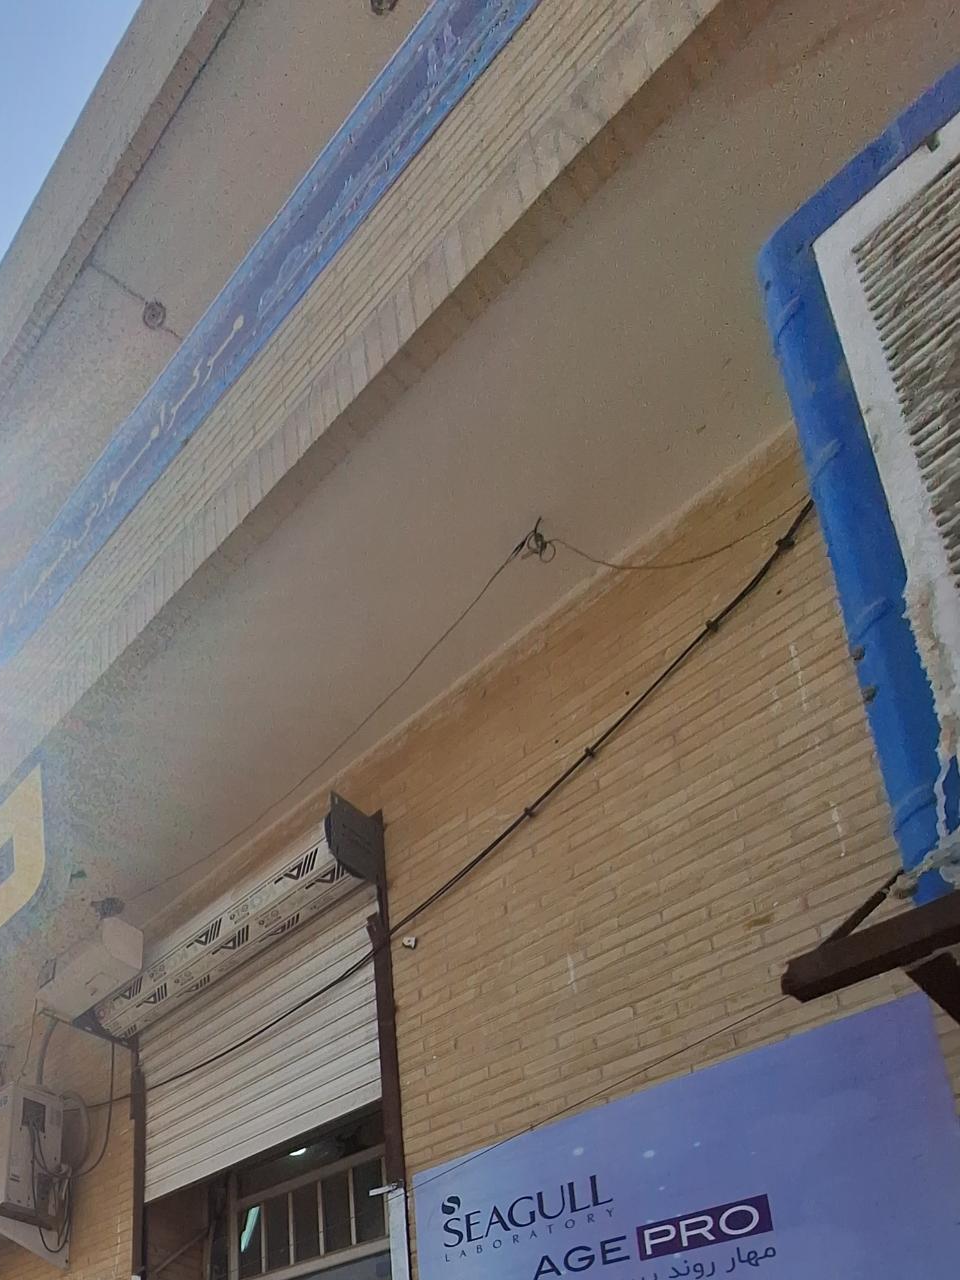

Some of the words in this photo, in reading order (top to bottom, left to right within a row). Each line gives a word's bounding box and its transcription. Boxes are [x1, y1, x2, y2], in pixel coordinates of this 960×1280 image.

[442, 1174, 614, 1248] SEAGULL
[444, 1207, 615, 1262] LABORATORY
[643, 1203, 761, 1256] PRO
[668, 1260, 717, 1280] روند
[726, 1245, 777, 1273] مهار
